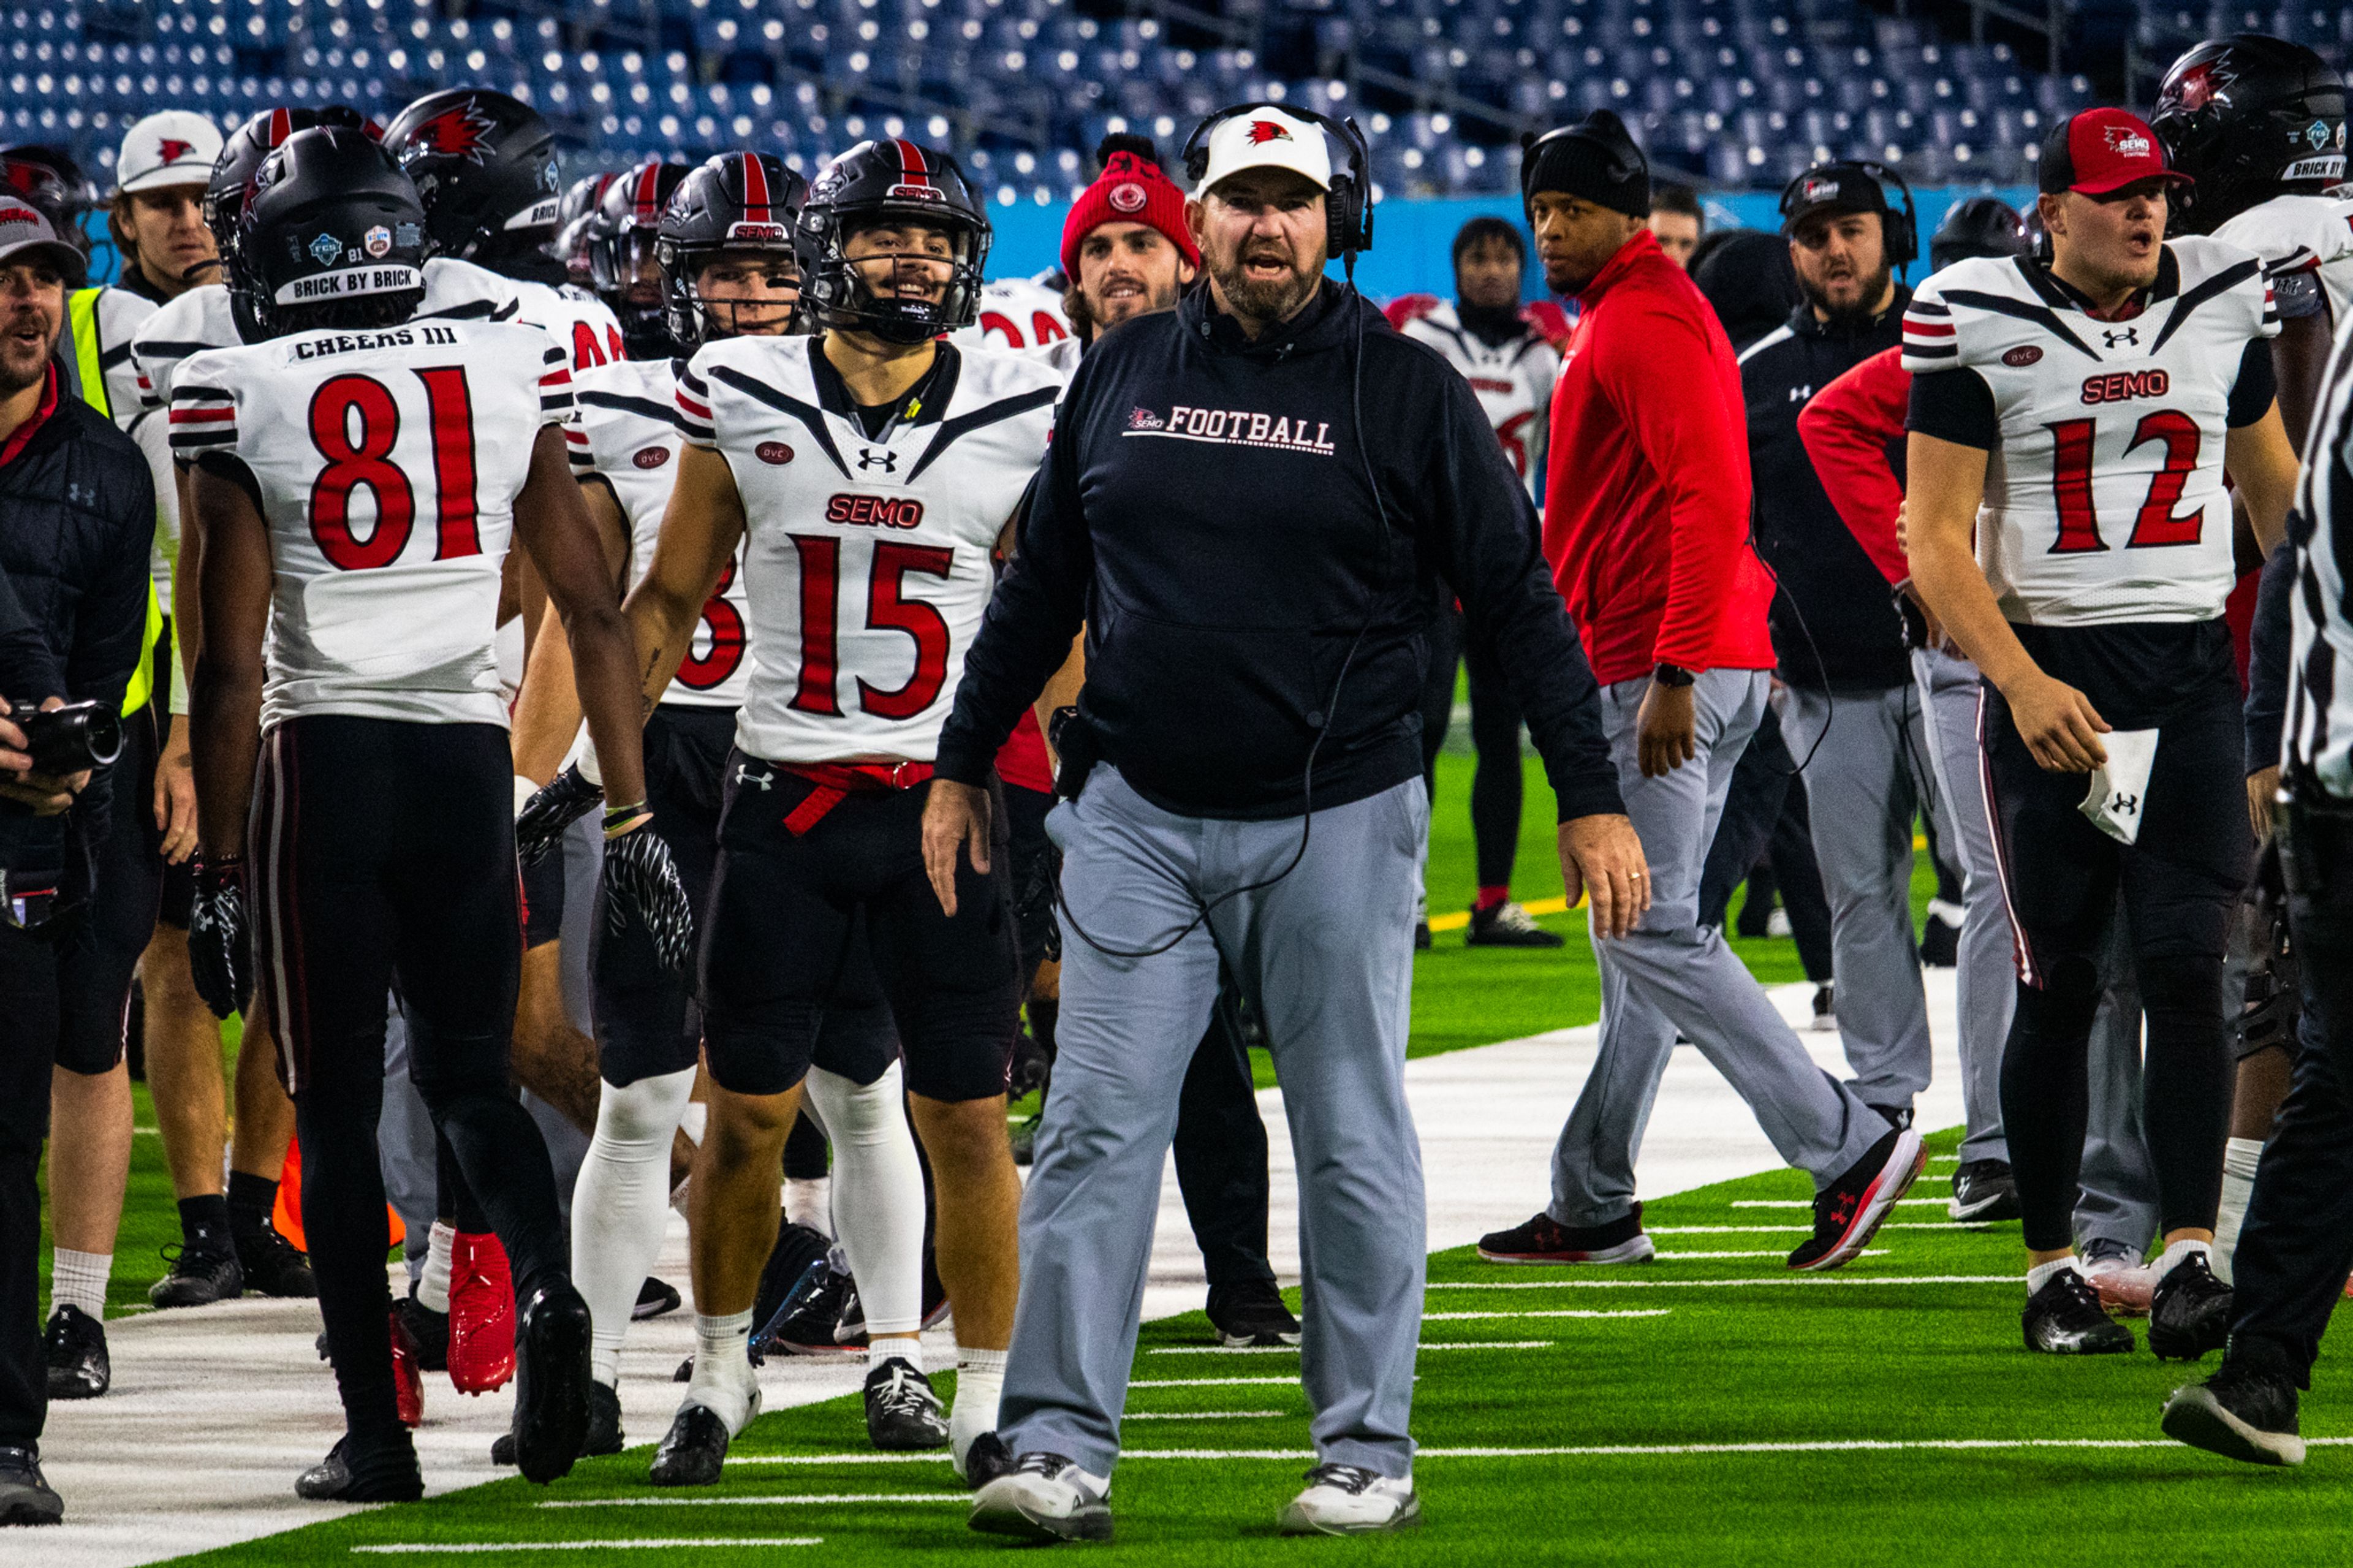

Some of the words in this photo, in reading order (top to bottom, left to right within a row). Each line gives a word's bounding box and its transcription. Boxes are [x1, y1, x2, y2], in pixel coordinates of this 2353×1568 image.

[2119, 138, 2150, 151] SEMO
[2294, 161, 2328, 176] BRICK
[348, 247, 363, 262] 81
[294, 276, 341, 298] BRICK
[347, 273, 367, 291] BY
[374, 270, 412, 288] BRICK
[295, 329, 414, 360] CHEERS
[421, 327, 458, 344] III
[2080, 369, 2169, 404] SEMO
[1134, 419, 1164, 429] SEMO
[1165, 406, 1335, 450] FOOTBALL
[308, 364, 483, 572] 81
[2040, 409, 2205, 554] 12
[825, 493, 925, 529] SEMO
[784, 532, 955, 721] 15
